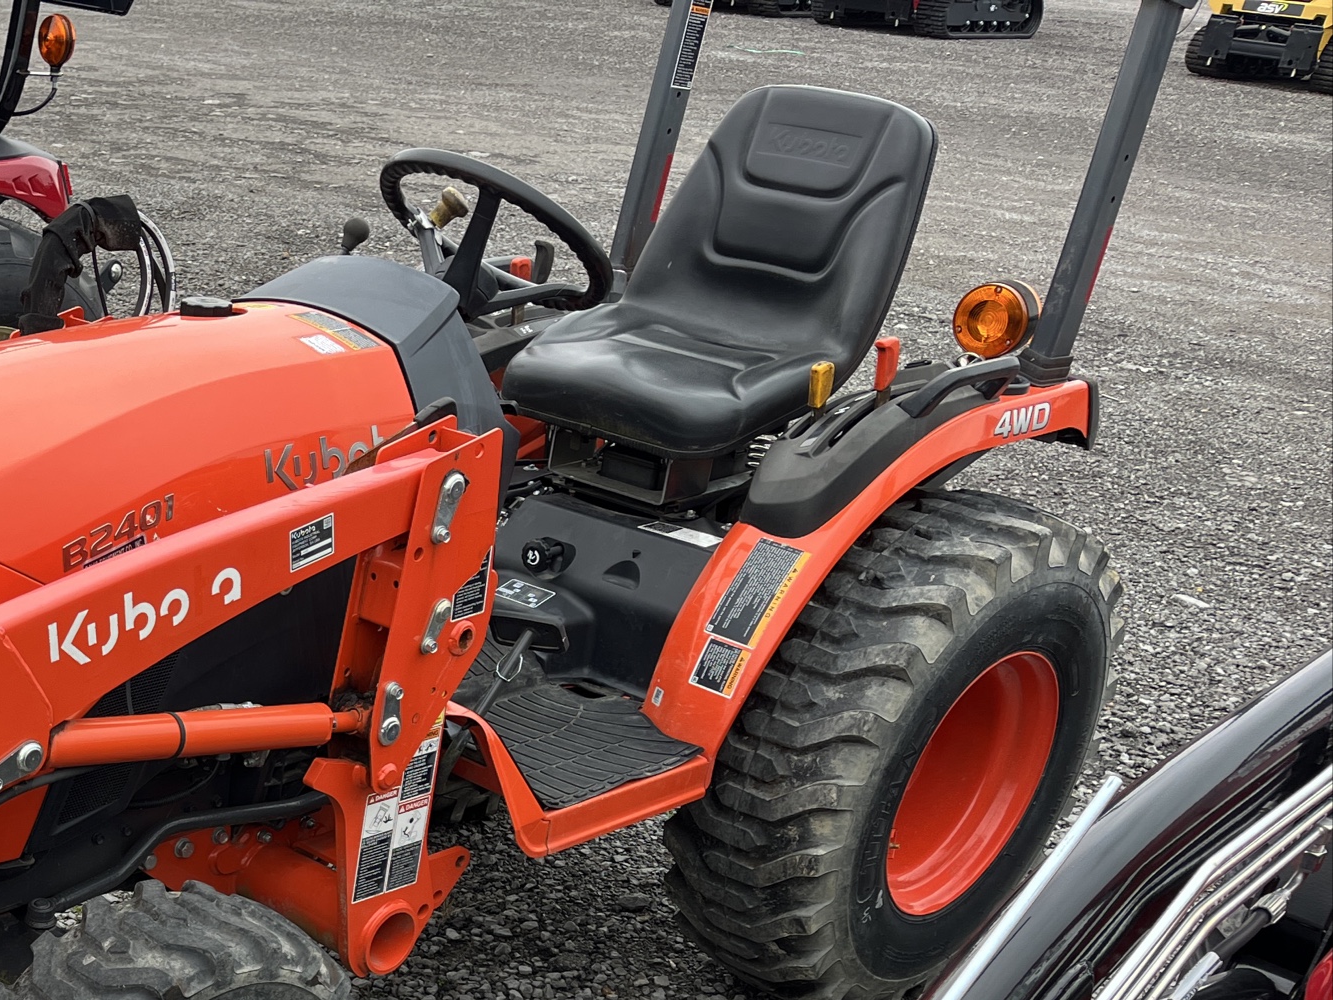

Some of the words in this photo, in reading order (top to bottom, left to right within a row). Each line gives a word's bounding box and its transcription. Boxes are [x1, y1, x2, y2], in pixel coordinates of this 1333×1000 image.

[993, 402, 1052, 438] 4WD
[264, 425, 384, 491] Kubot
[62, 493, 175, 573] B2401
[48, 567, 242, 665] Kuboa
[765, 576, 794, 619] WARNING
[726, 662, 742, 690] WARNING
[375, 789, 398, 802] DANGER
[404, 798, 429, 811] DANGER
